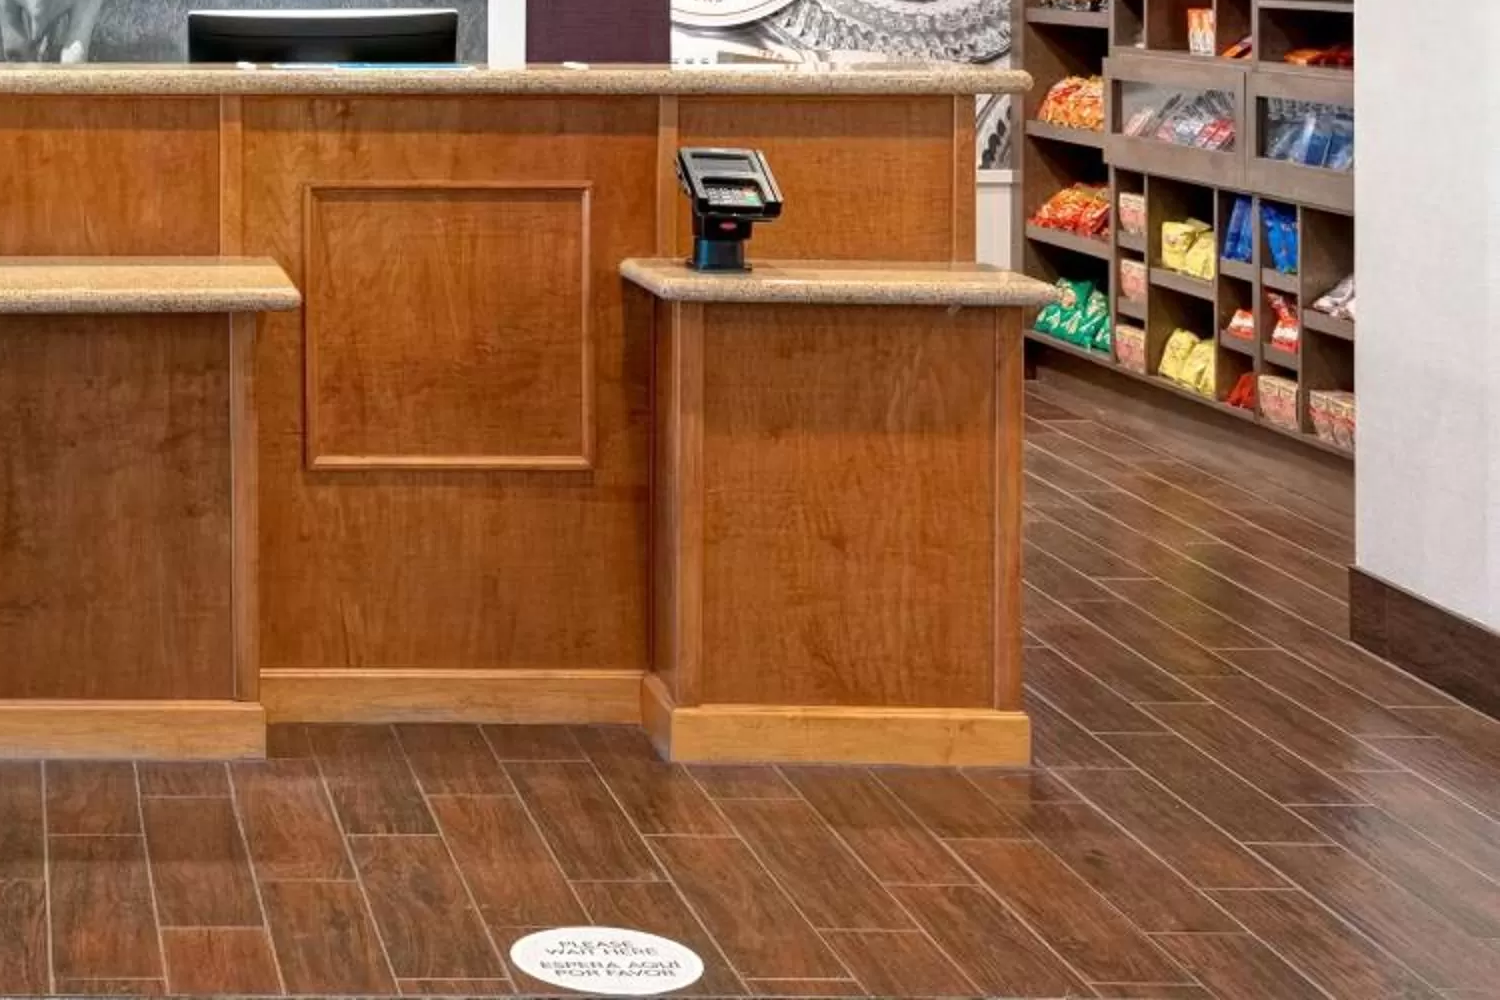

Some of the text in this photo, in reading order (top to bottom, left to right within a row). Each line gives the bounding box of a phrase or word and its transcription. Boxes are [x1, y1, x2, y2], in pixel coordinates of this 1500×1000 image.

[545, 948, 658, 956] WAIT HERE
[539, 960, 621, 969] ESPERA
[555, 969, 676, 977] POR FAVOR
